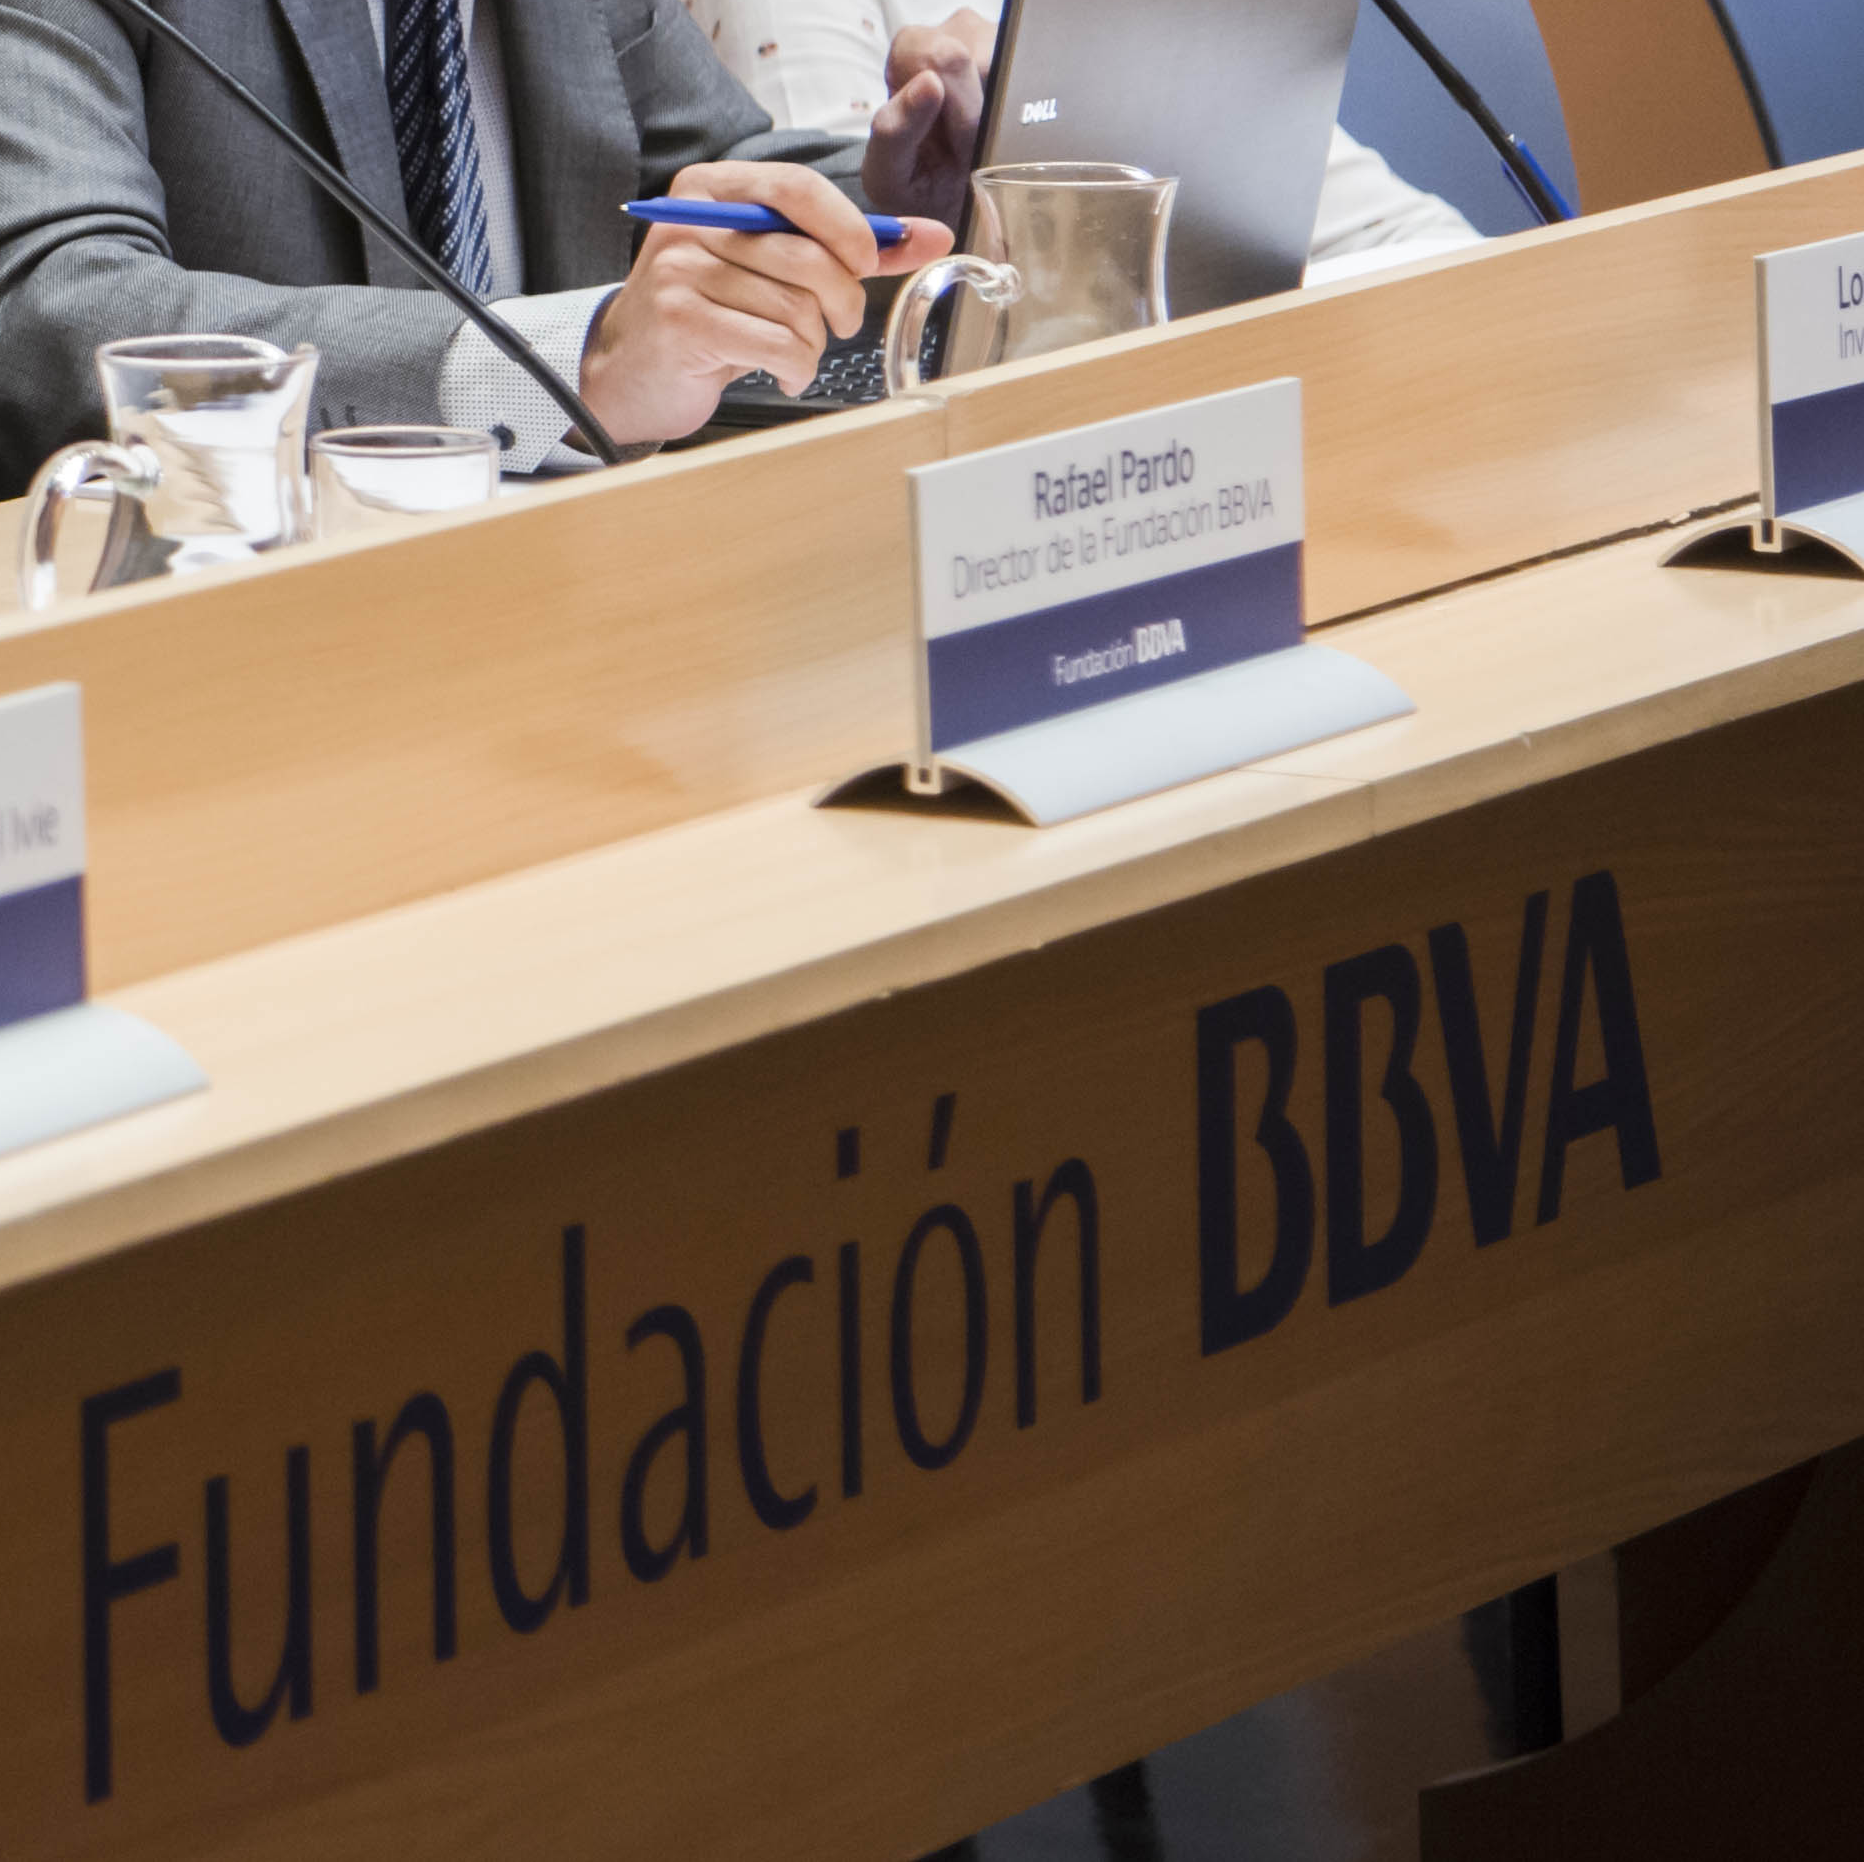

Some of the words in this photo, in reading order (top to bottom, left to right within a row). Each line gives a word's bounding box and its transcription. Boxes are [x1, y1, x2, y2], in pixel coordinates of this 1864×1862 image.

[1034, 456, 1112, 520] Rafael
[1122, 439, 1195, 498] Pardo
[953, 541, 1039, 598] Director
[1048, 533, 1073, 574] de
[1079, 527, 1097, 565] la
[1102, 495, 1212, 559] Fundación
[1217, 478, 1273, 531] BBVA
[1053, 638, 1133, 686] Fundación
[1134, 618, 1185, 664] BBVA
[5, 802, 60, 853] Ivie
[80, 1092, 1102, 1805] Fundación
[1195, 868, 1663, 1358] BBVA
